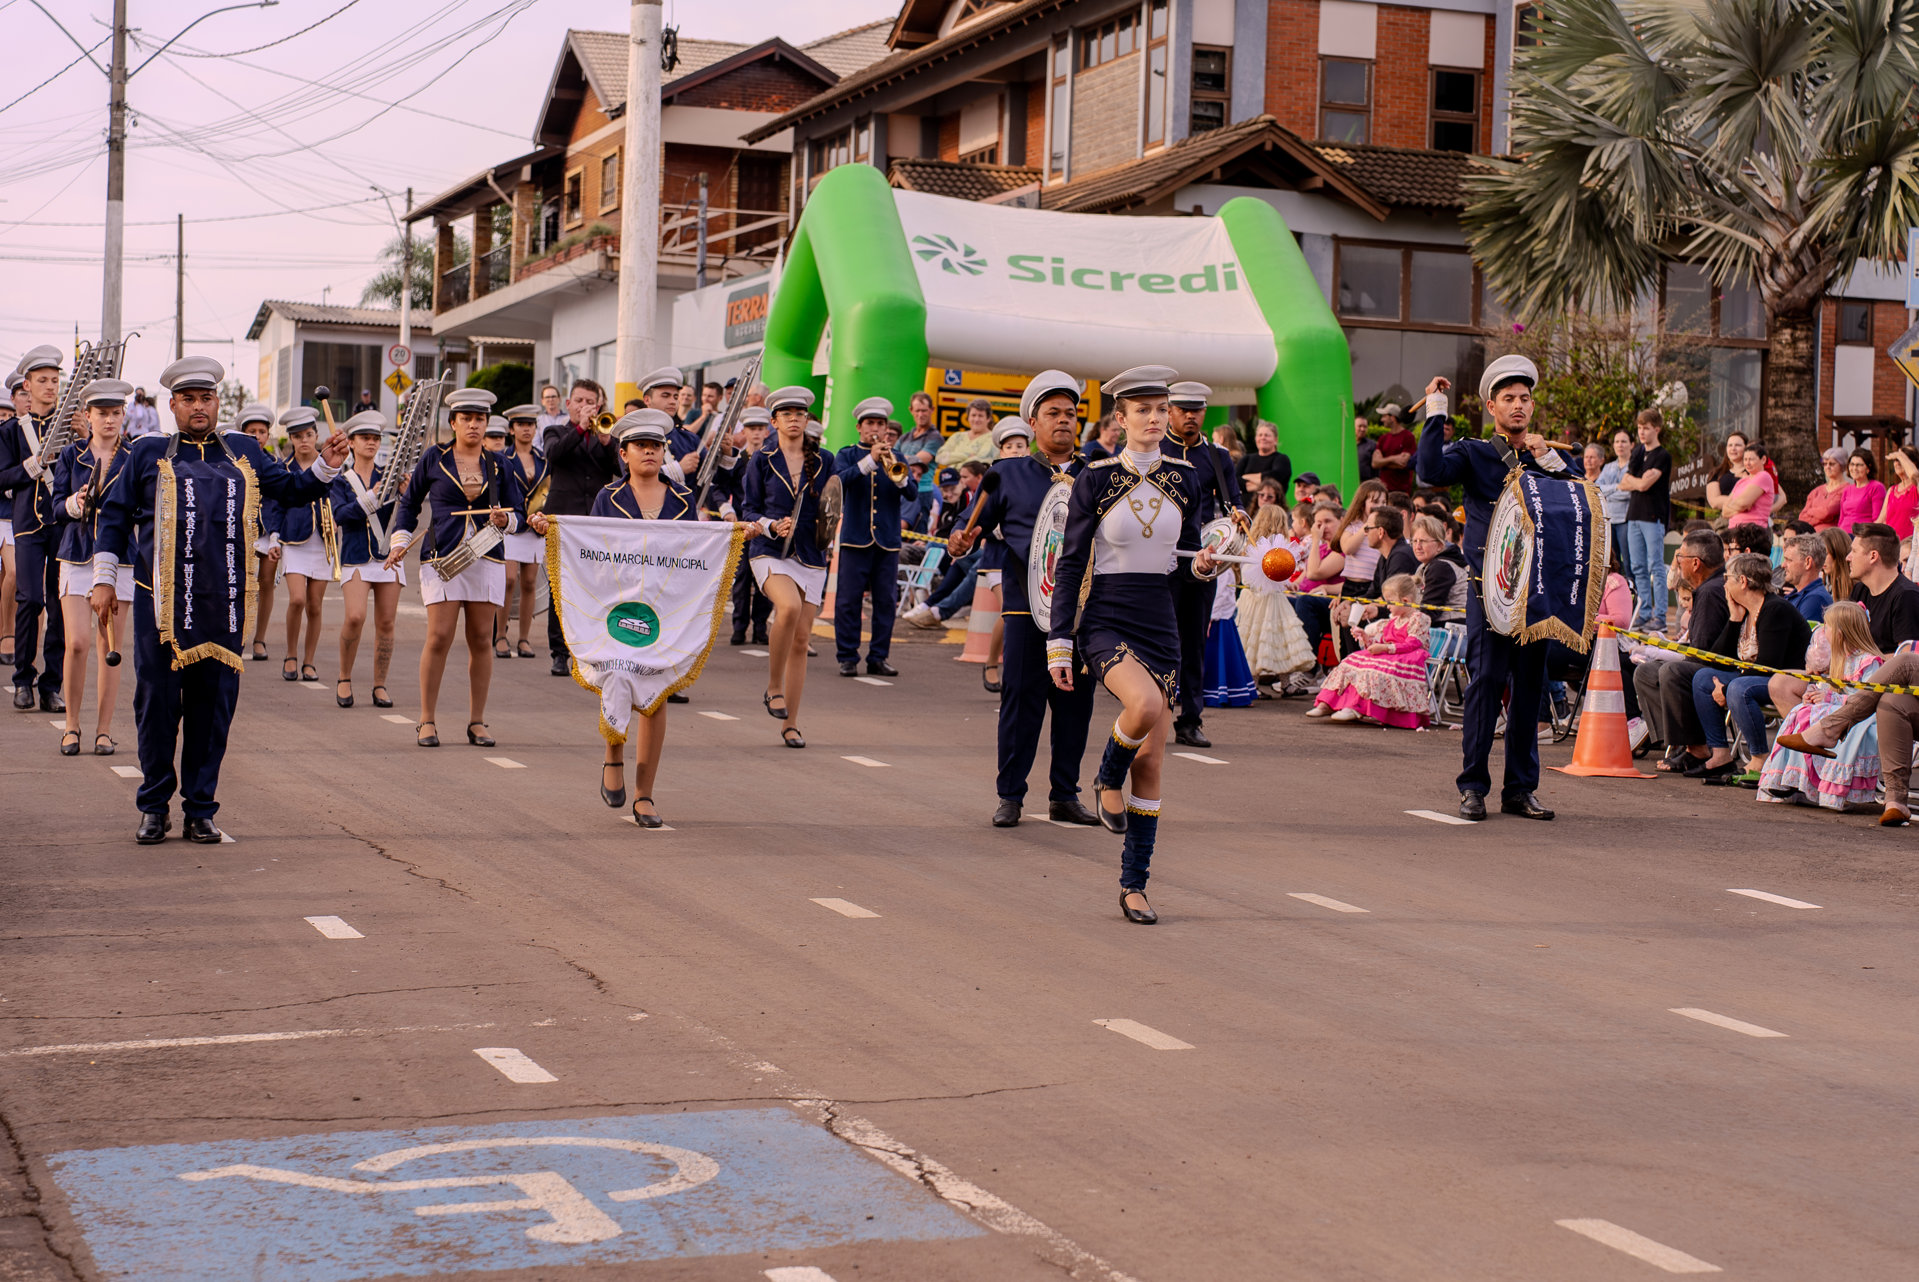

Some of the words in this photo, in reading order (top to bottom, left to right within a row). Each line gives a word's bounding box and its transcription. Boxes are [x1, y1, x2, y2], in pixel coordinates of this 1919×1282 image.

[1006, 254, 1239, 294] Sicredi
[727, 293, 768, 328] TERRA
[184, 478, 196, 508] BANDA
[1669, 476, 1690, 495] ANDO
[184, 511, 196, 558] MARCIAL
[579, 548, 611, 563] BANDA
[613, 552, 655, 566] MARCIAL
[656, 556, 709, 571] MUNICIPAL
[1536, 537, 1544, 595] MUNICIPAL
[183, 563, 195, 629] MUNICIPAL
